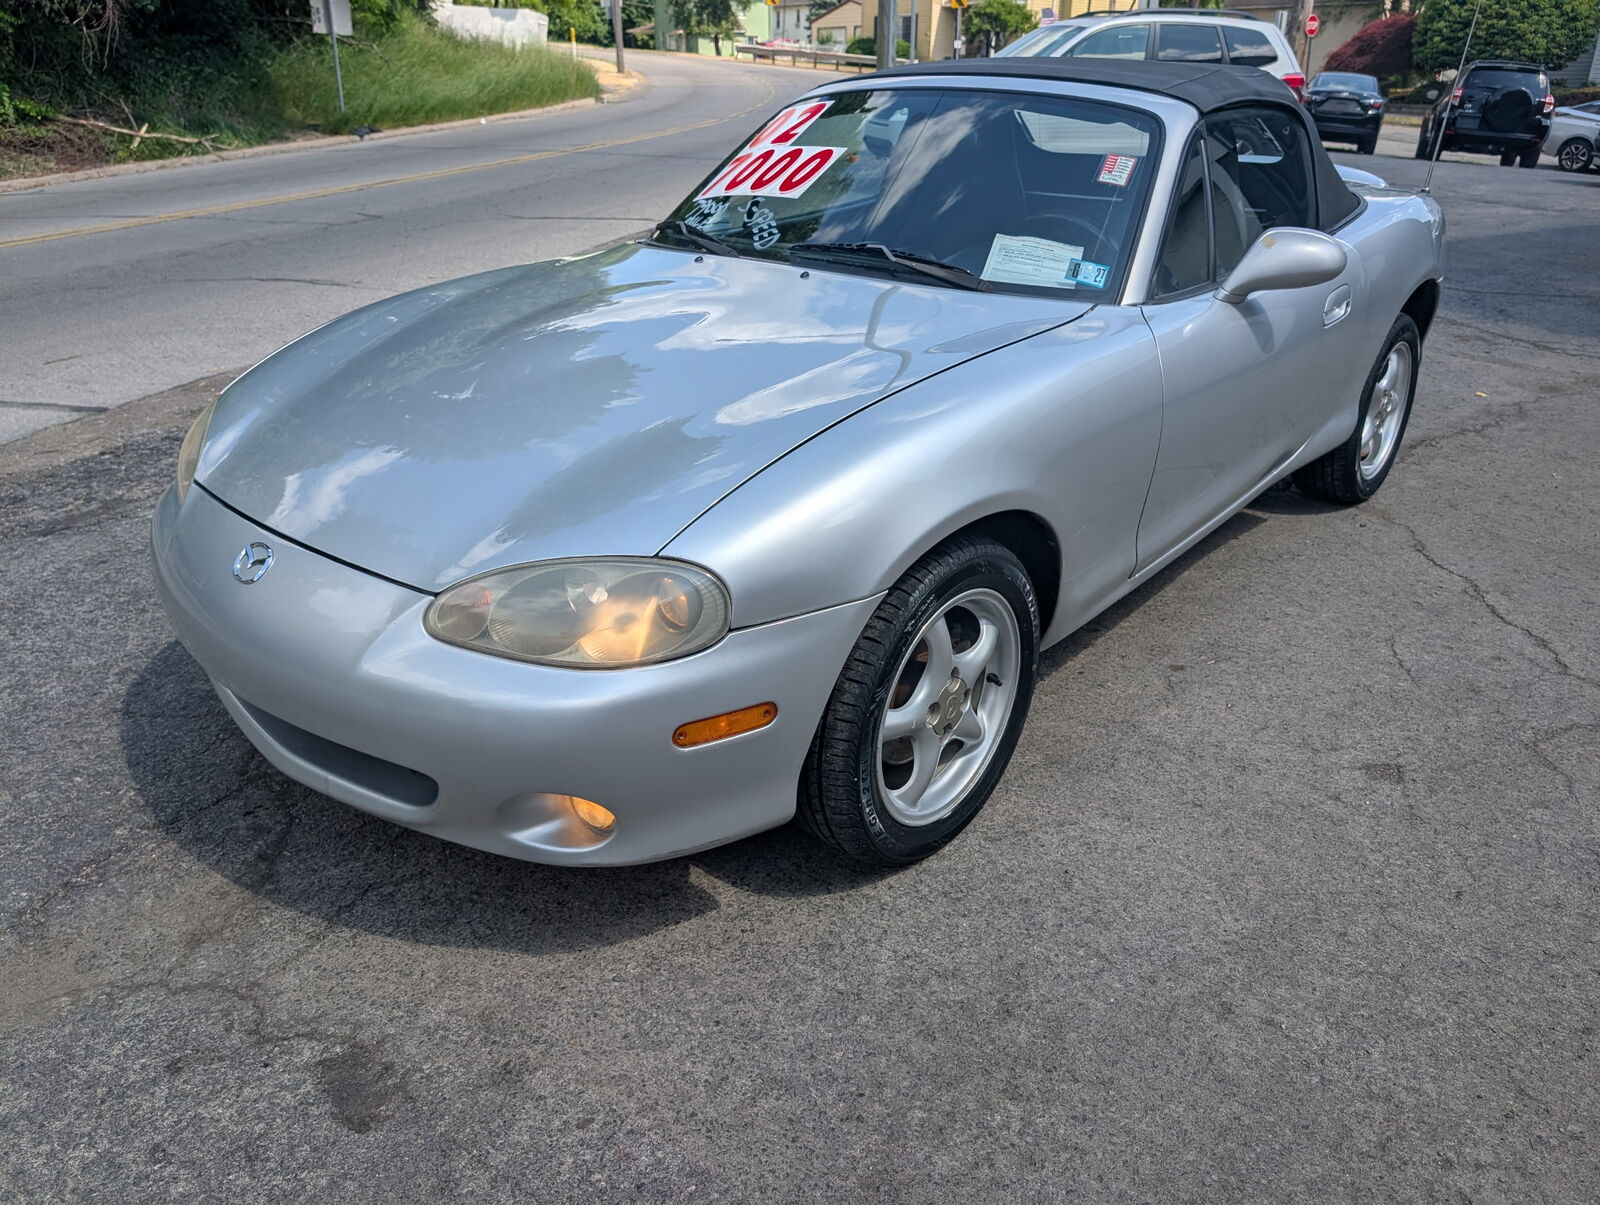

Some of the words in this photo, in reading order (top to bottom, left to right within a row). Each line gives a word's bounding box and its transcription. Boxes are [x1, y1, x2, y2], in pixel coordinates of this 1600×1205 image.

[749, 102, 827, 148] 02
[701, 148, 834, 197] 7000
[1093, 267, 1106, 284] 27
